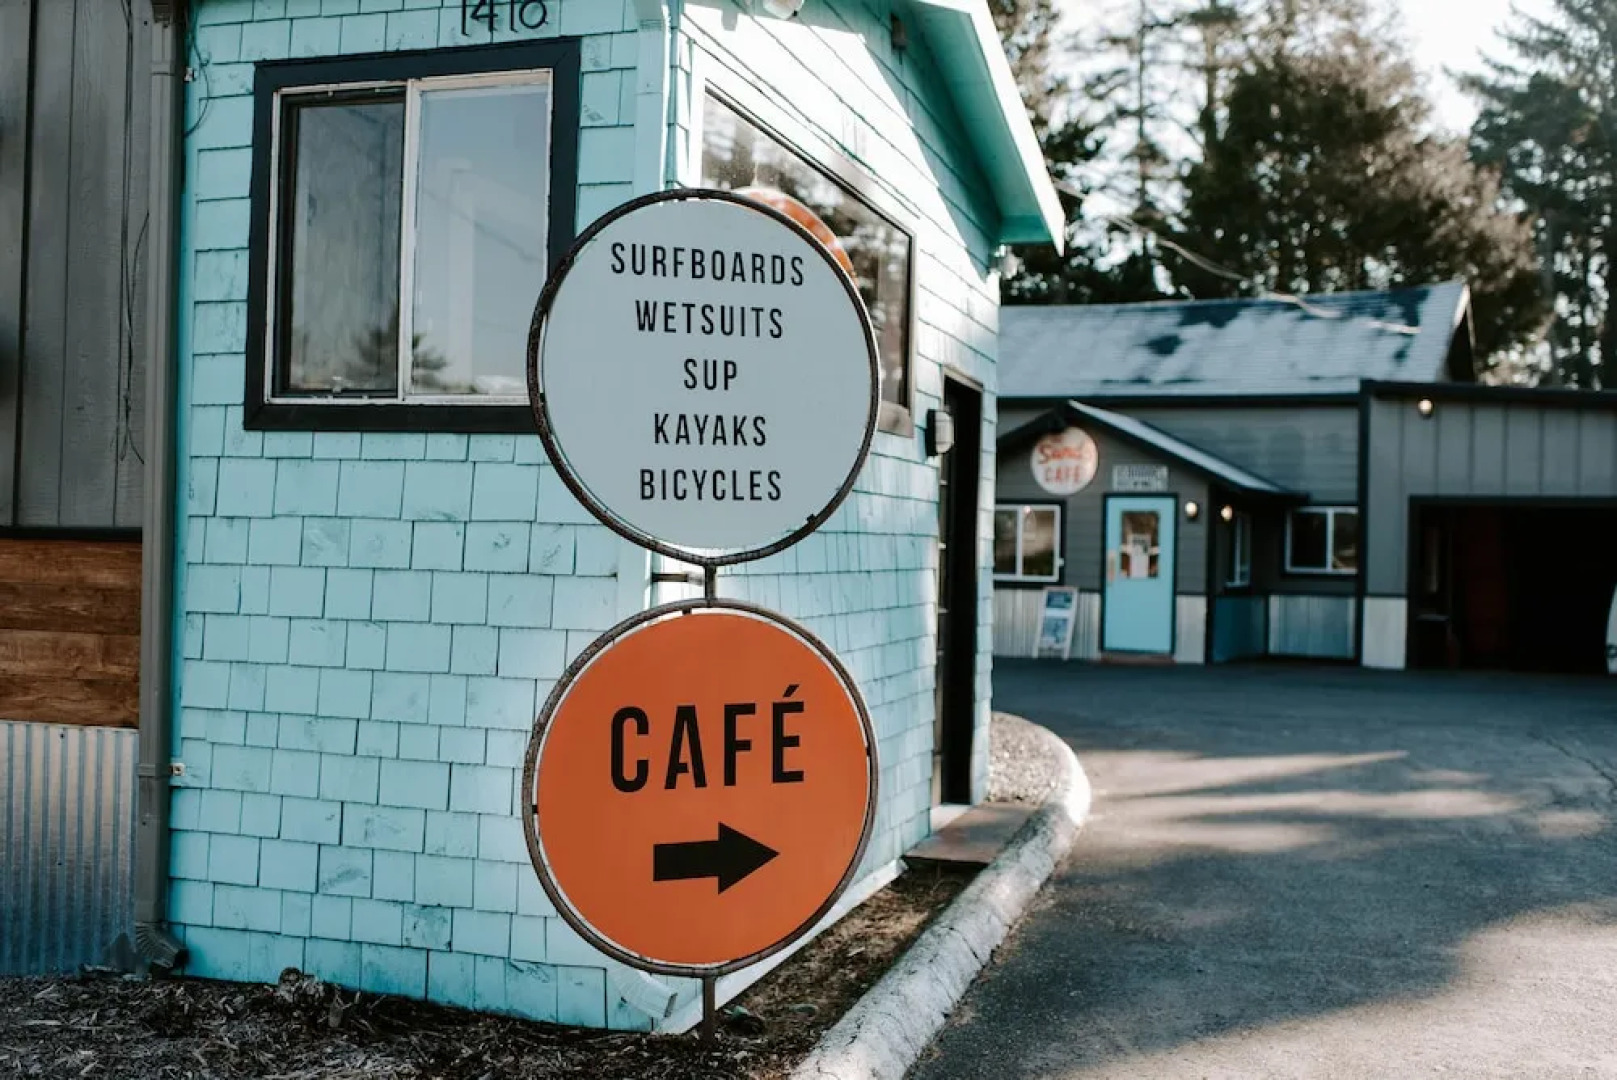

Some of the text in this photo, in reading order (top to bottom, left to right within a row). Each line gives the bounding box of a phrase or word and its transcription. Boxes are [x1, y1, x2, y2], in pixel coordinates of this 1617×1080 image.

[462, 0, 547, 36] 1410
[611, 242, 804, 287] SURFBOARDS
[635, 300, 783, 339] WETSUITS
[684, 359, 737, 391] SUP
[655, 414, 766, 447] KAYAKS
[640, 469, 782, 502] BICYCLES
[611, 684, 805, 793] CAFÉ
